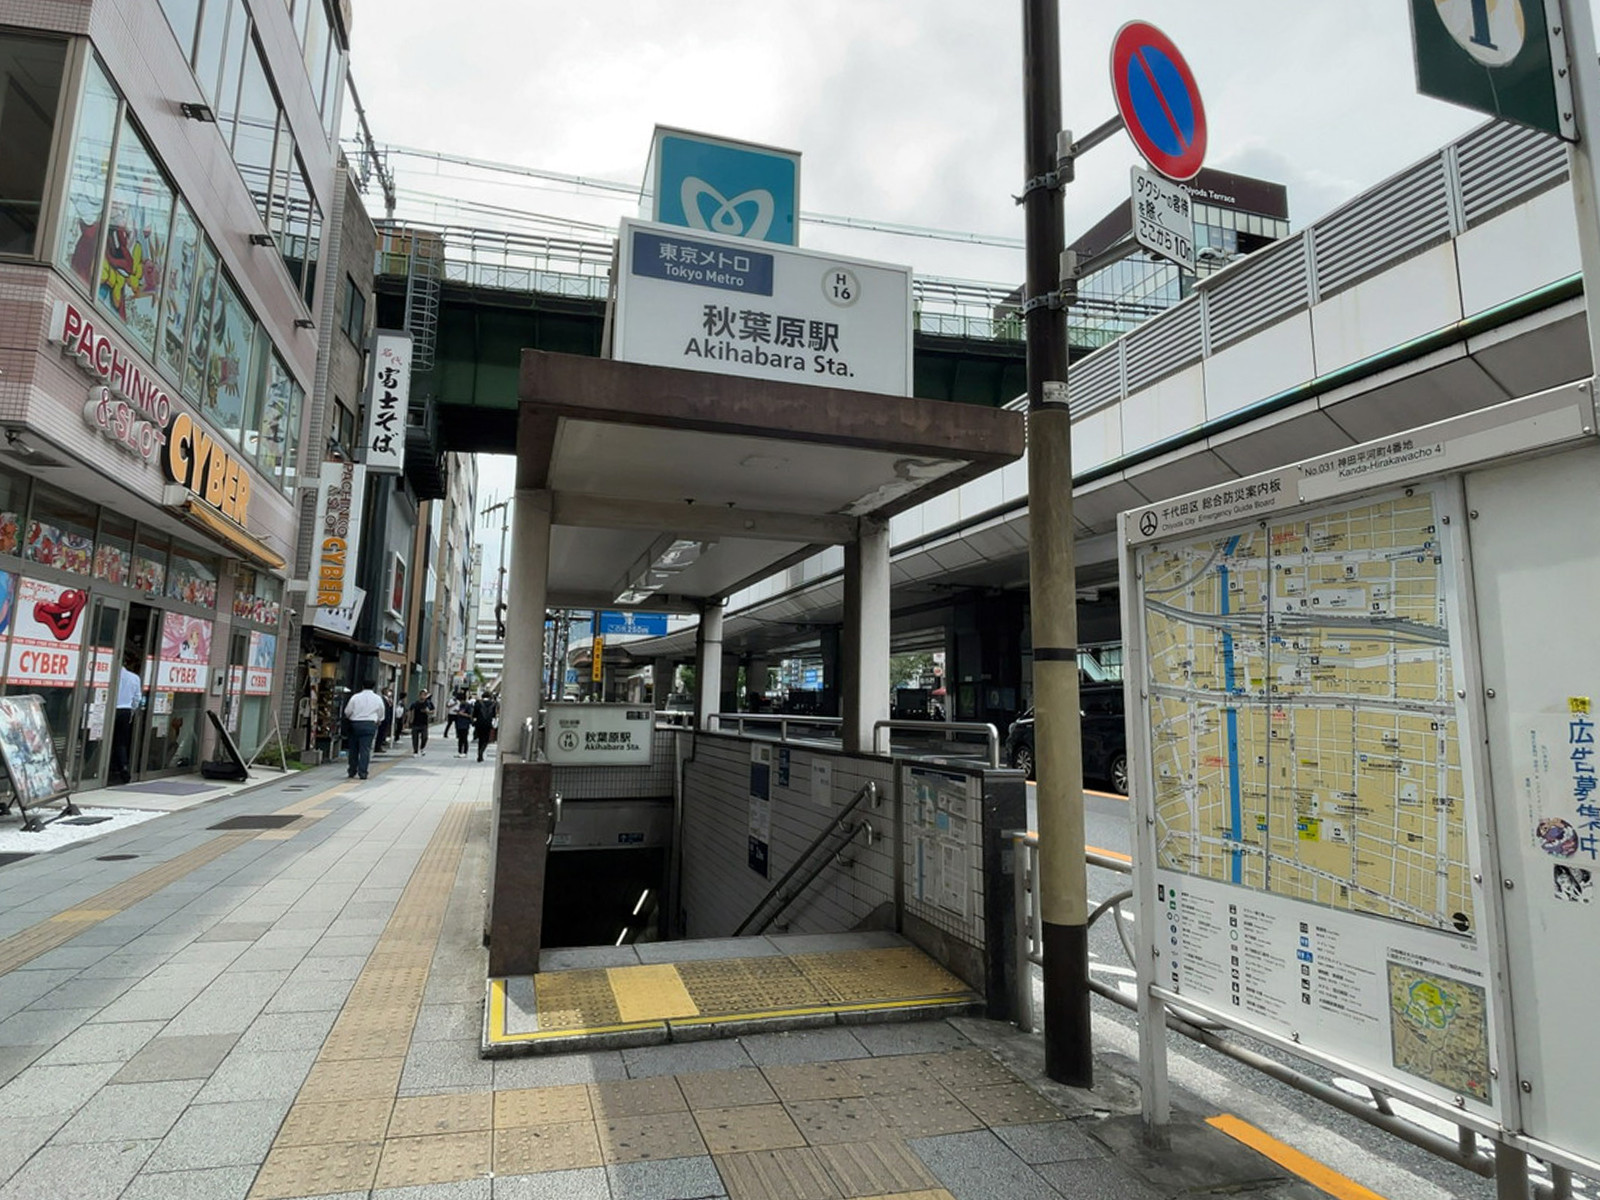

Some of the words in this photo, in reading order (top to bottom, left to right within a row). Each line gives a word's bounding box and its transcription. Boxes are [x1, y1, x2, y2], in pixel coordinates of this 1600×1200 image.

[1208, 189, 1236, 203] Terrace
[1138, 199, 1164, 225] を除く
[658, 242, 750, 273] 東京メトロ
[664, 262, 703, 282] Tokyo
[706, 269, 745, 287] Metro
[836, 273, 847, 286] H
[832, 285, 851, 301] 16
[703, 303, 840, 354] 秋葉原駅
[62, 304, 170, 427] PACHINKO
[684, 337, 806, 372] Akihabara
[814, 356, 855, 378] Sta.
[372, 366, 400, 457] 富士そば
[96, 387, 112, 428] &
[114, 402, 166, 465] SLOT
[1434, 444, 1442, 453] 4
[169, 412, 250, 526] CYBER
[1304, 461, 1335, 477] No.031
[1161, 499, 1200, 520] 千代田区
[1202, 478, 1282, 511] 総合防災案内板
[1254, 498, 1276, 509] Board
[316, 536, 348, 607] CYBER
[19, 650, 69, 676] CYBER
[169, 666, 197, 684] CYBER
[563, 740, 574, 748] 16
[584, 743, 624, 751] Akihabara
